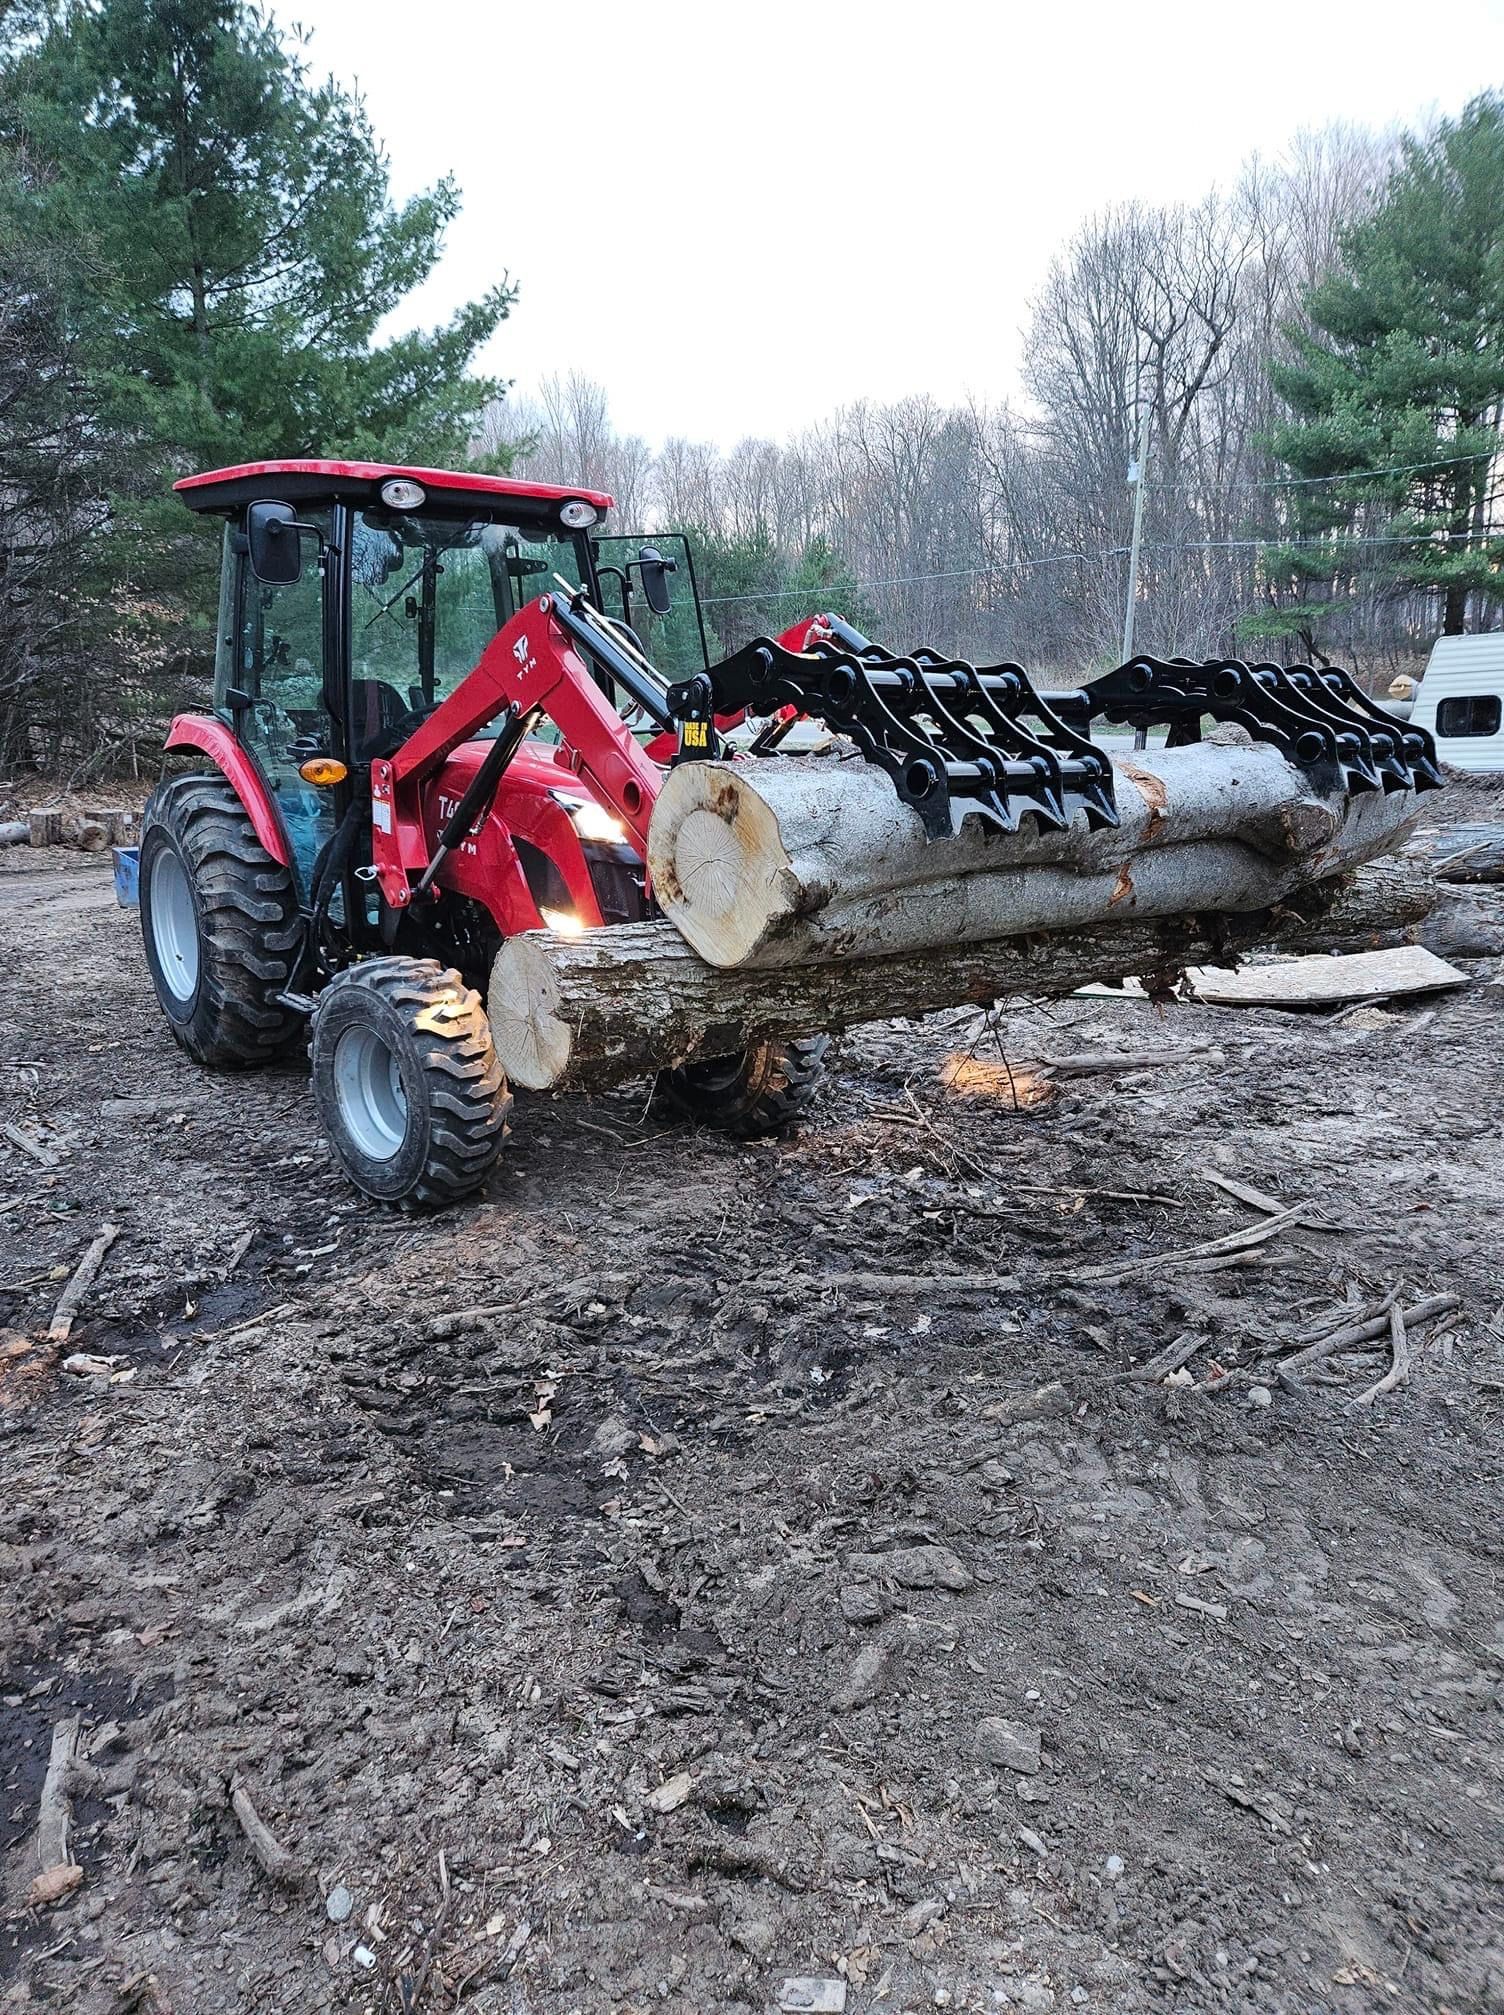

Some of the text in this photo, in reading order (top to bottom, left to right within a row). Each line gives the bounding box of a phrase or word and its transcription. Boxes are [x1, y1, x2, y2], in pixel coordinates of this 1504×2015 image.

[516, 657, 537, 680] TYM
[684, 730, 708, 747] USA
[438, 795, 461, 819] T4
[460, 841, 477, 855] YM
